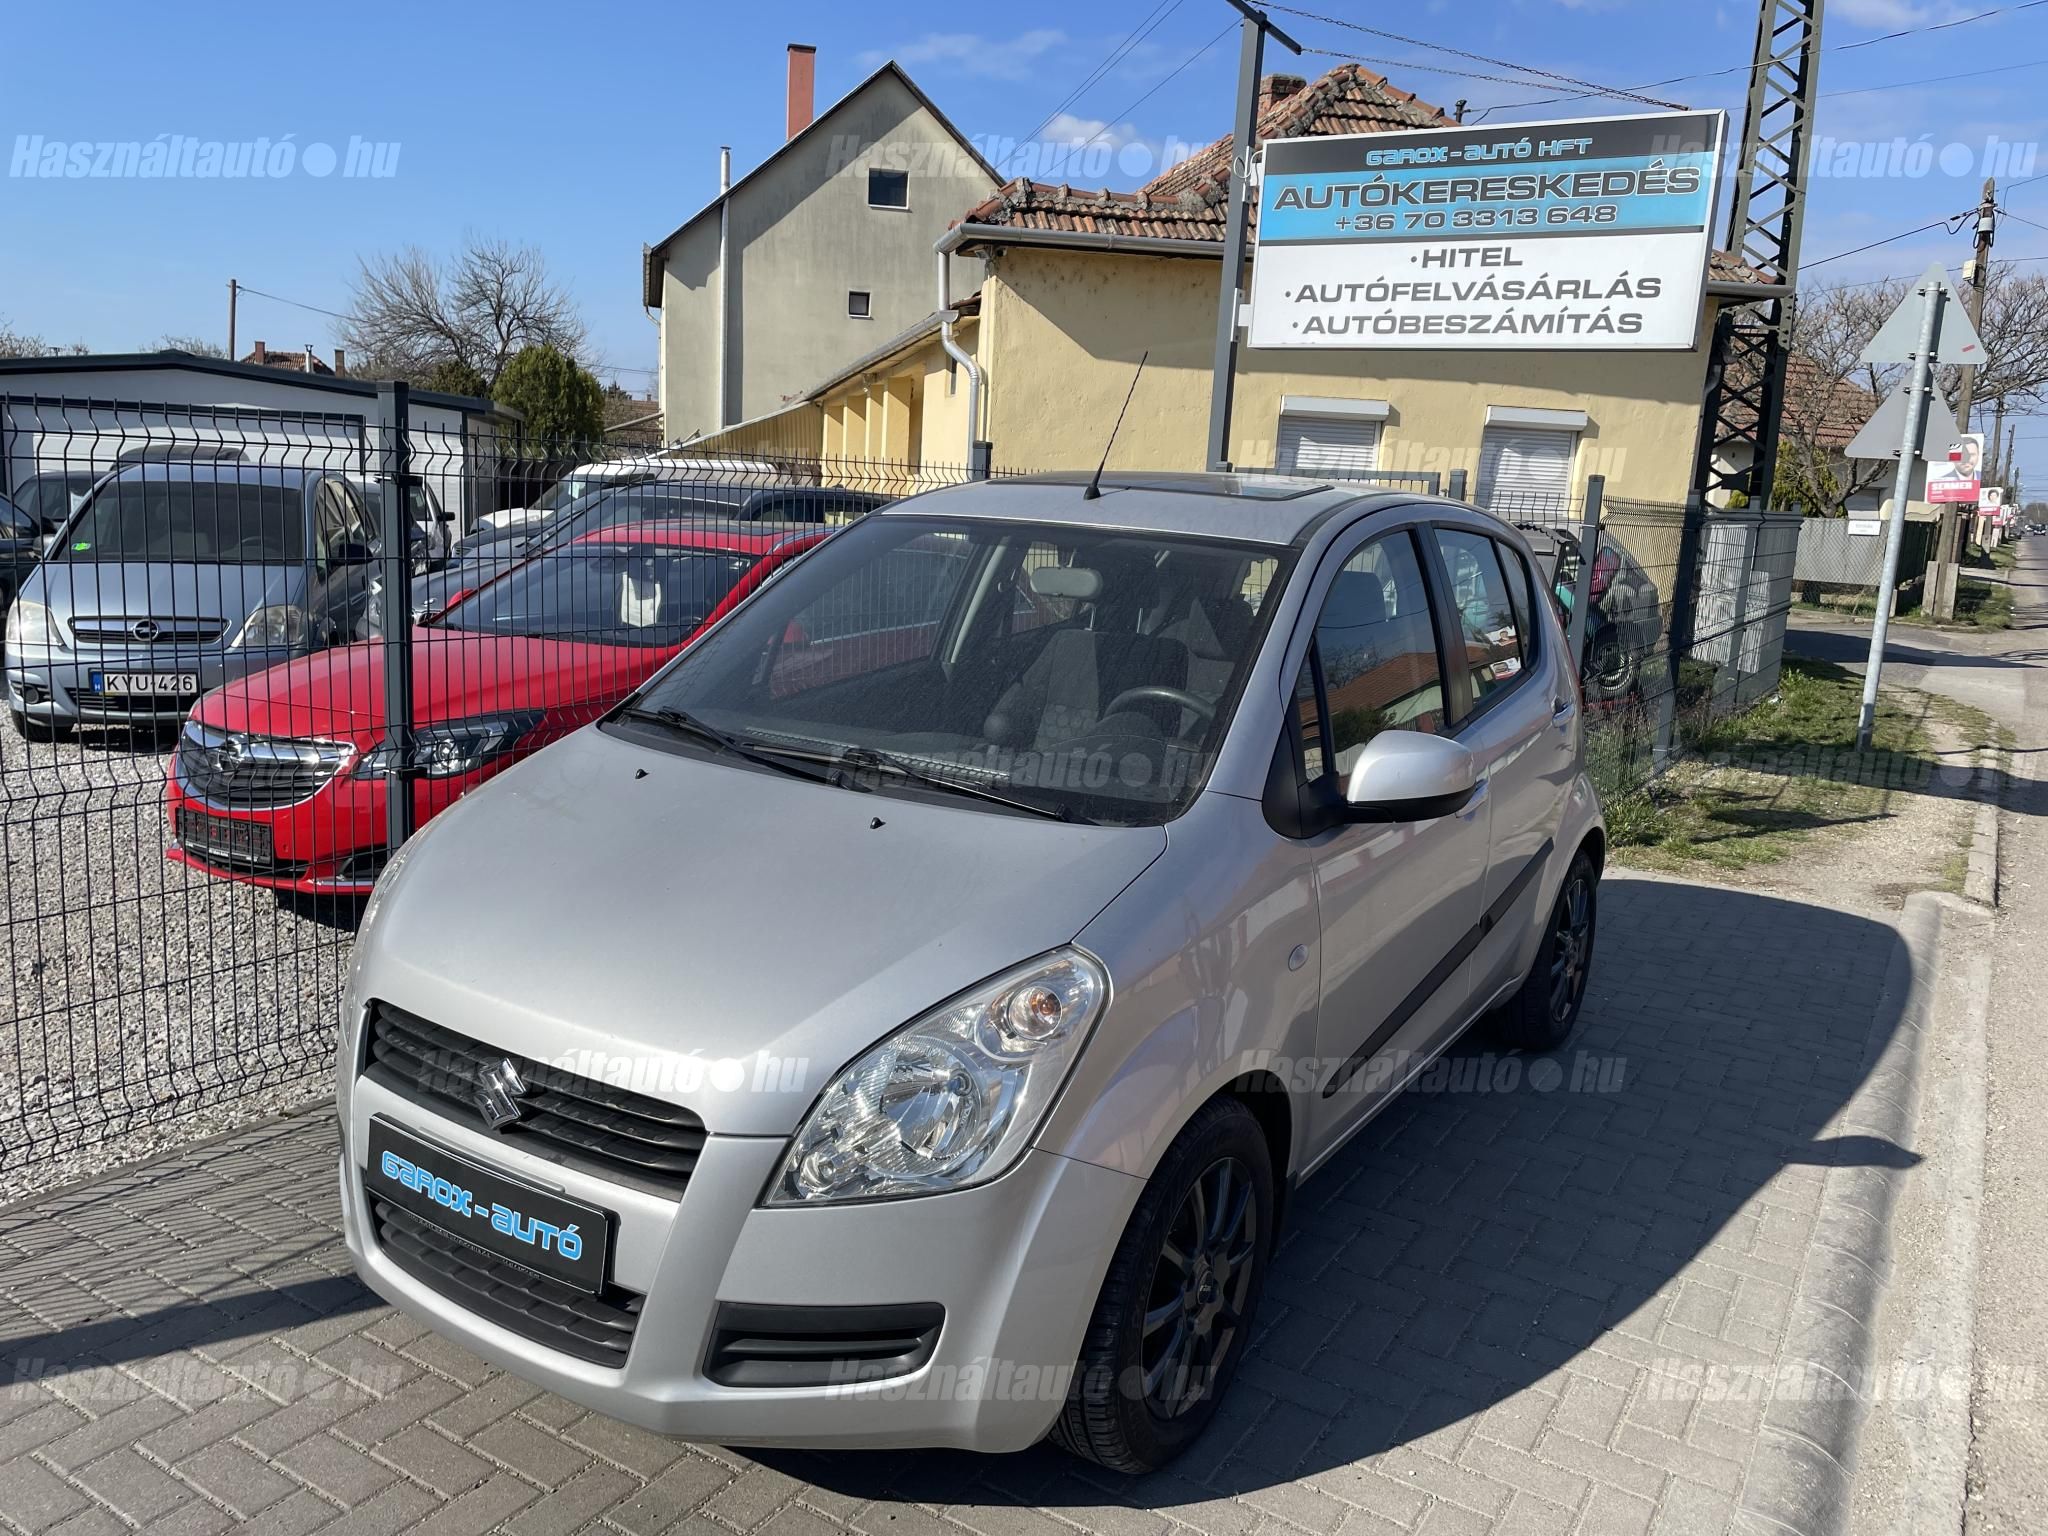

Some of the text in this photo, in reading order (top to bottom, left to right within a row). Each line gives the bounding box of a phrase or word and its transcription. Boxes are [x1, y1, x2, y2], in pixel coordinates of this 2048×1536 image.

[1273, 159, 1700, 210] AUTÓKERESKEDÉS
[1335, 205, 1618, 232] +36 70 3313 648
[1421, 246, 1523, 268] HITEL
